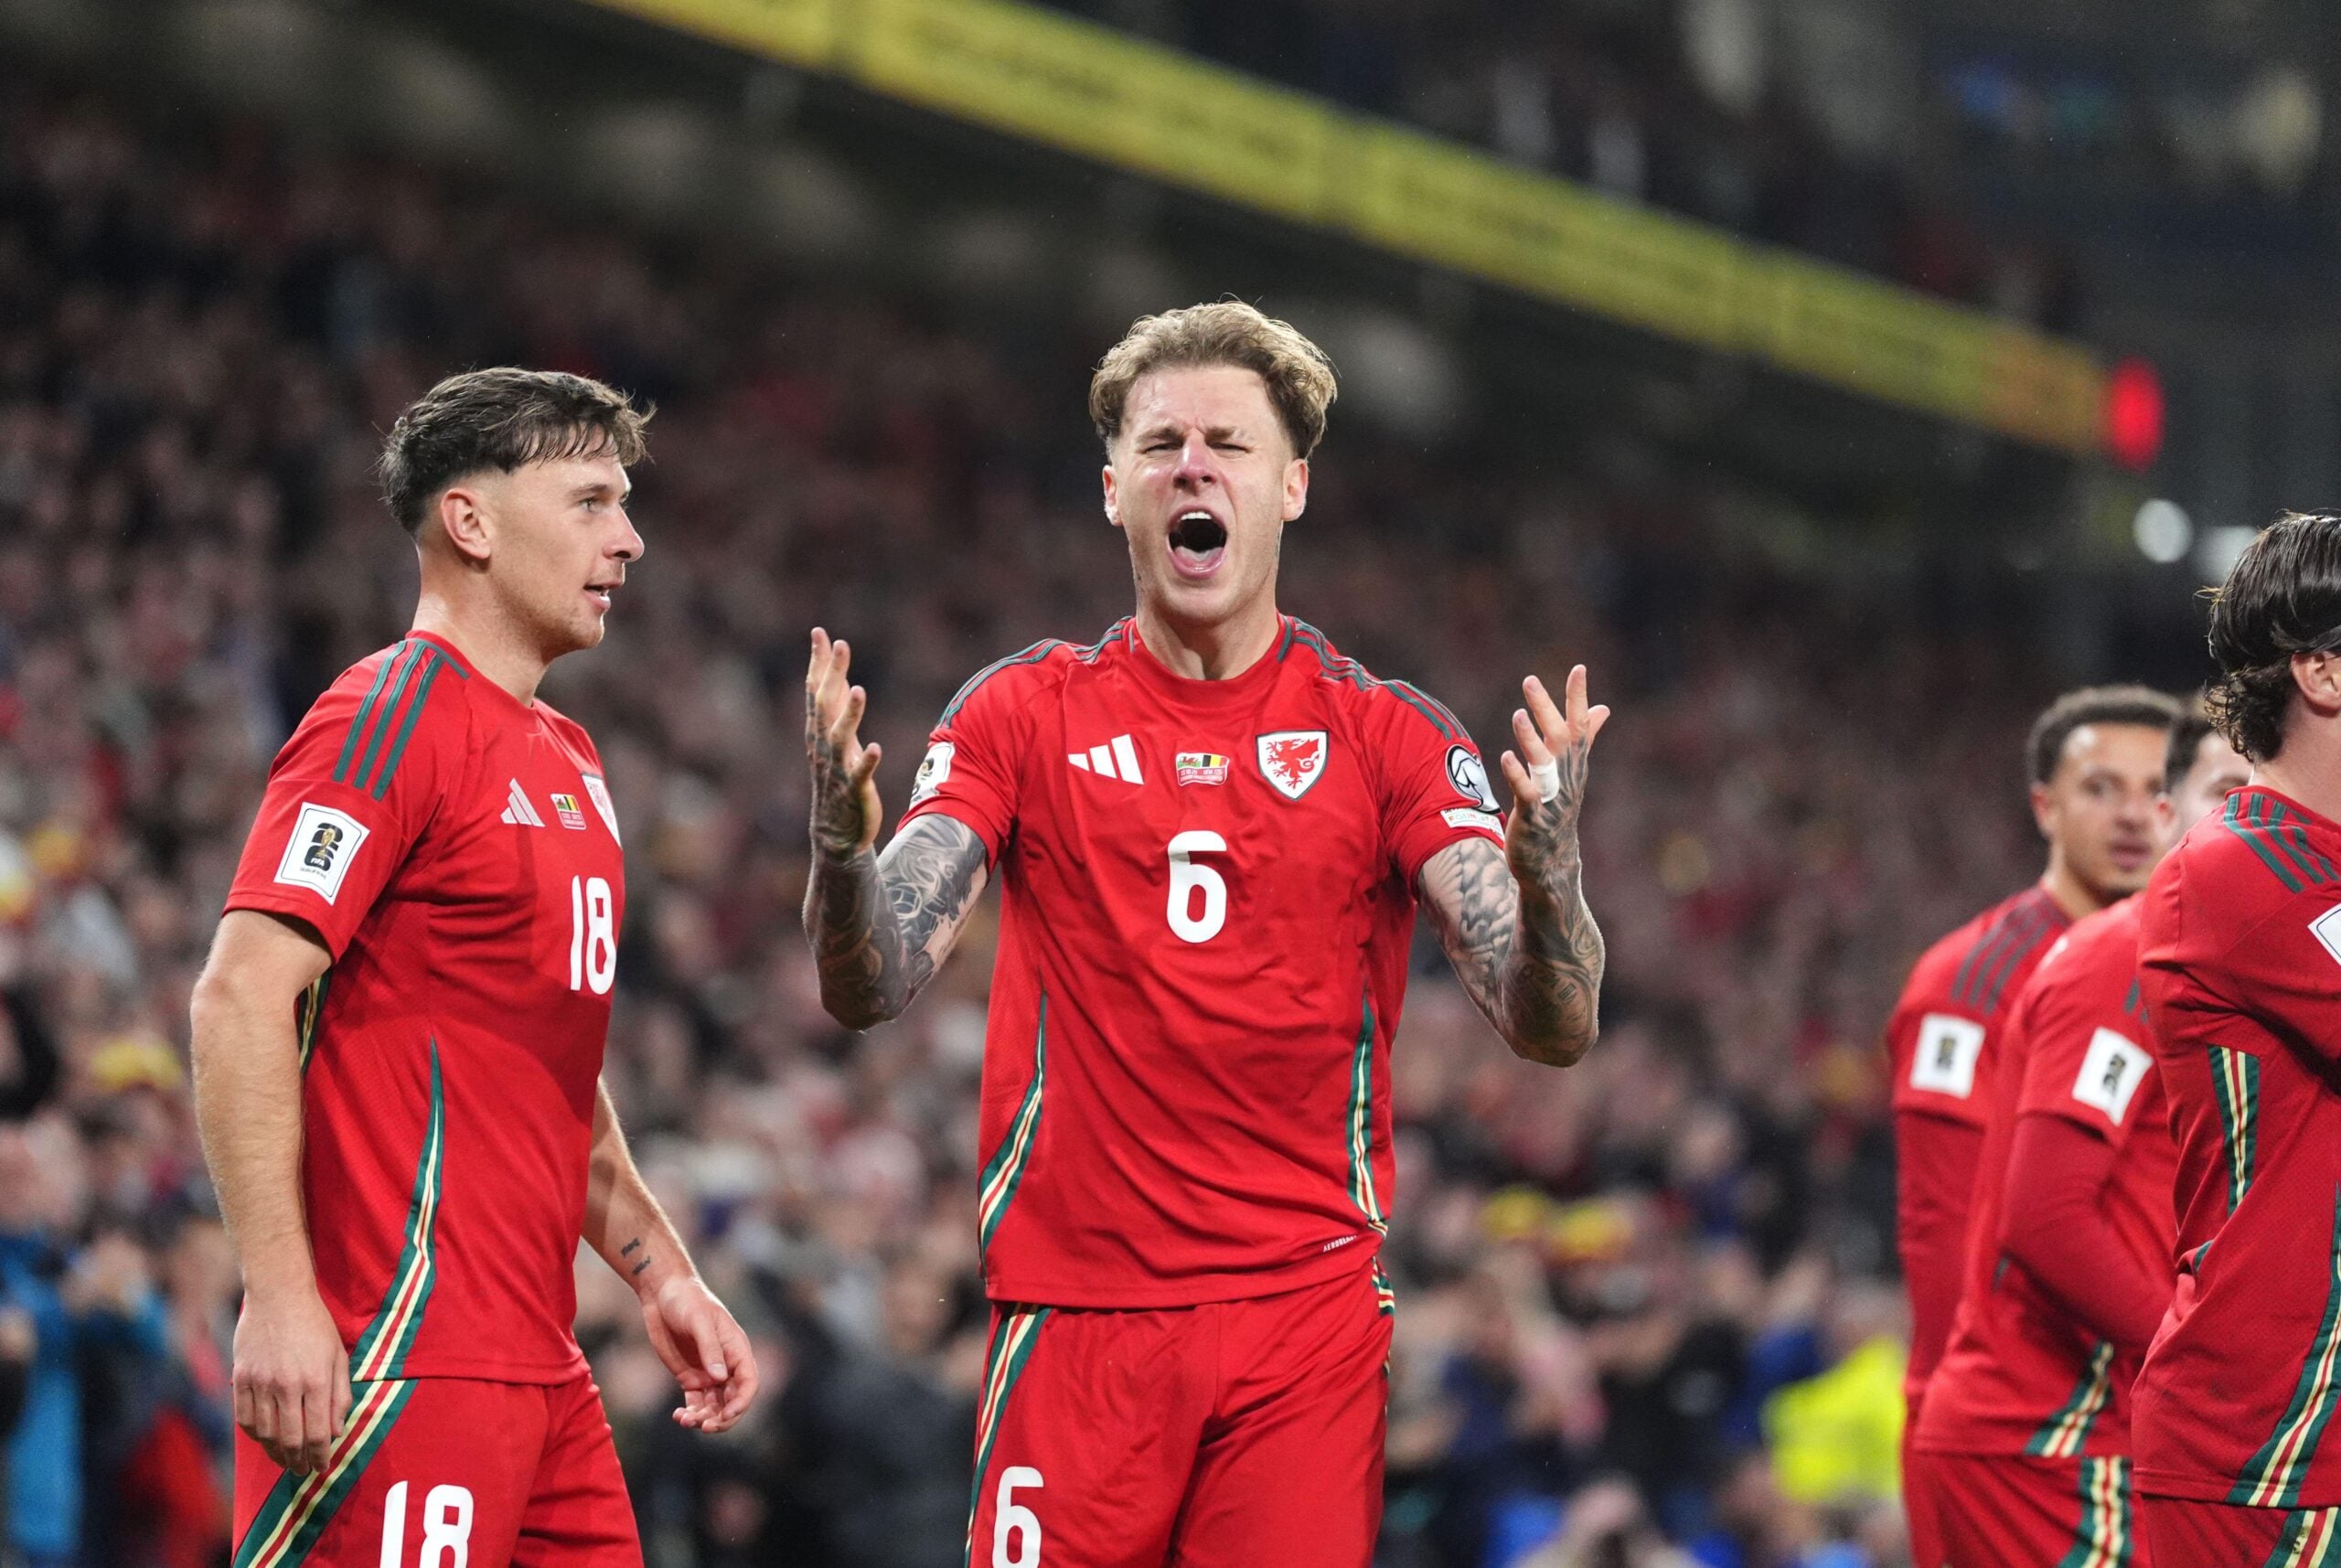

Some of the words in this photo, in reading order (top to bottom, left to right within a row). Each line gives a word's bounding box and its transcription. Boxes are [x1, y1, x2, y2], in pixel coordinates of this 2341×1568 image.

[570, 874, 617, 996] 18
[1167, 830, 1227, 944] 6
[379, 1480, 475, 1568] 18
[992, 1466, 1044, 1568] 6
